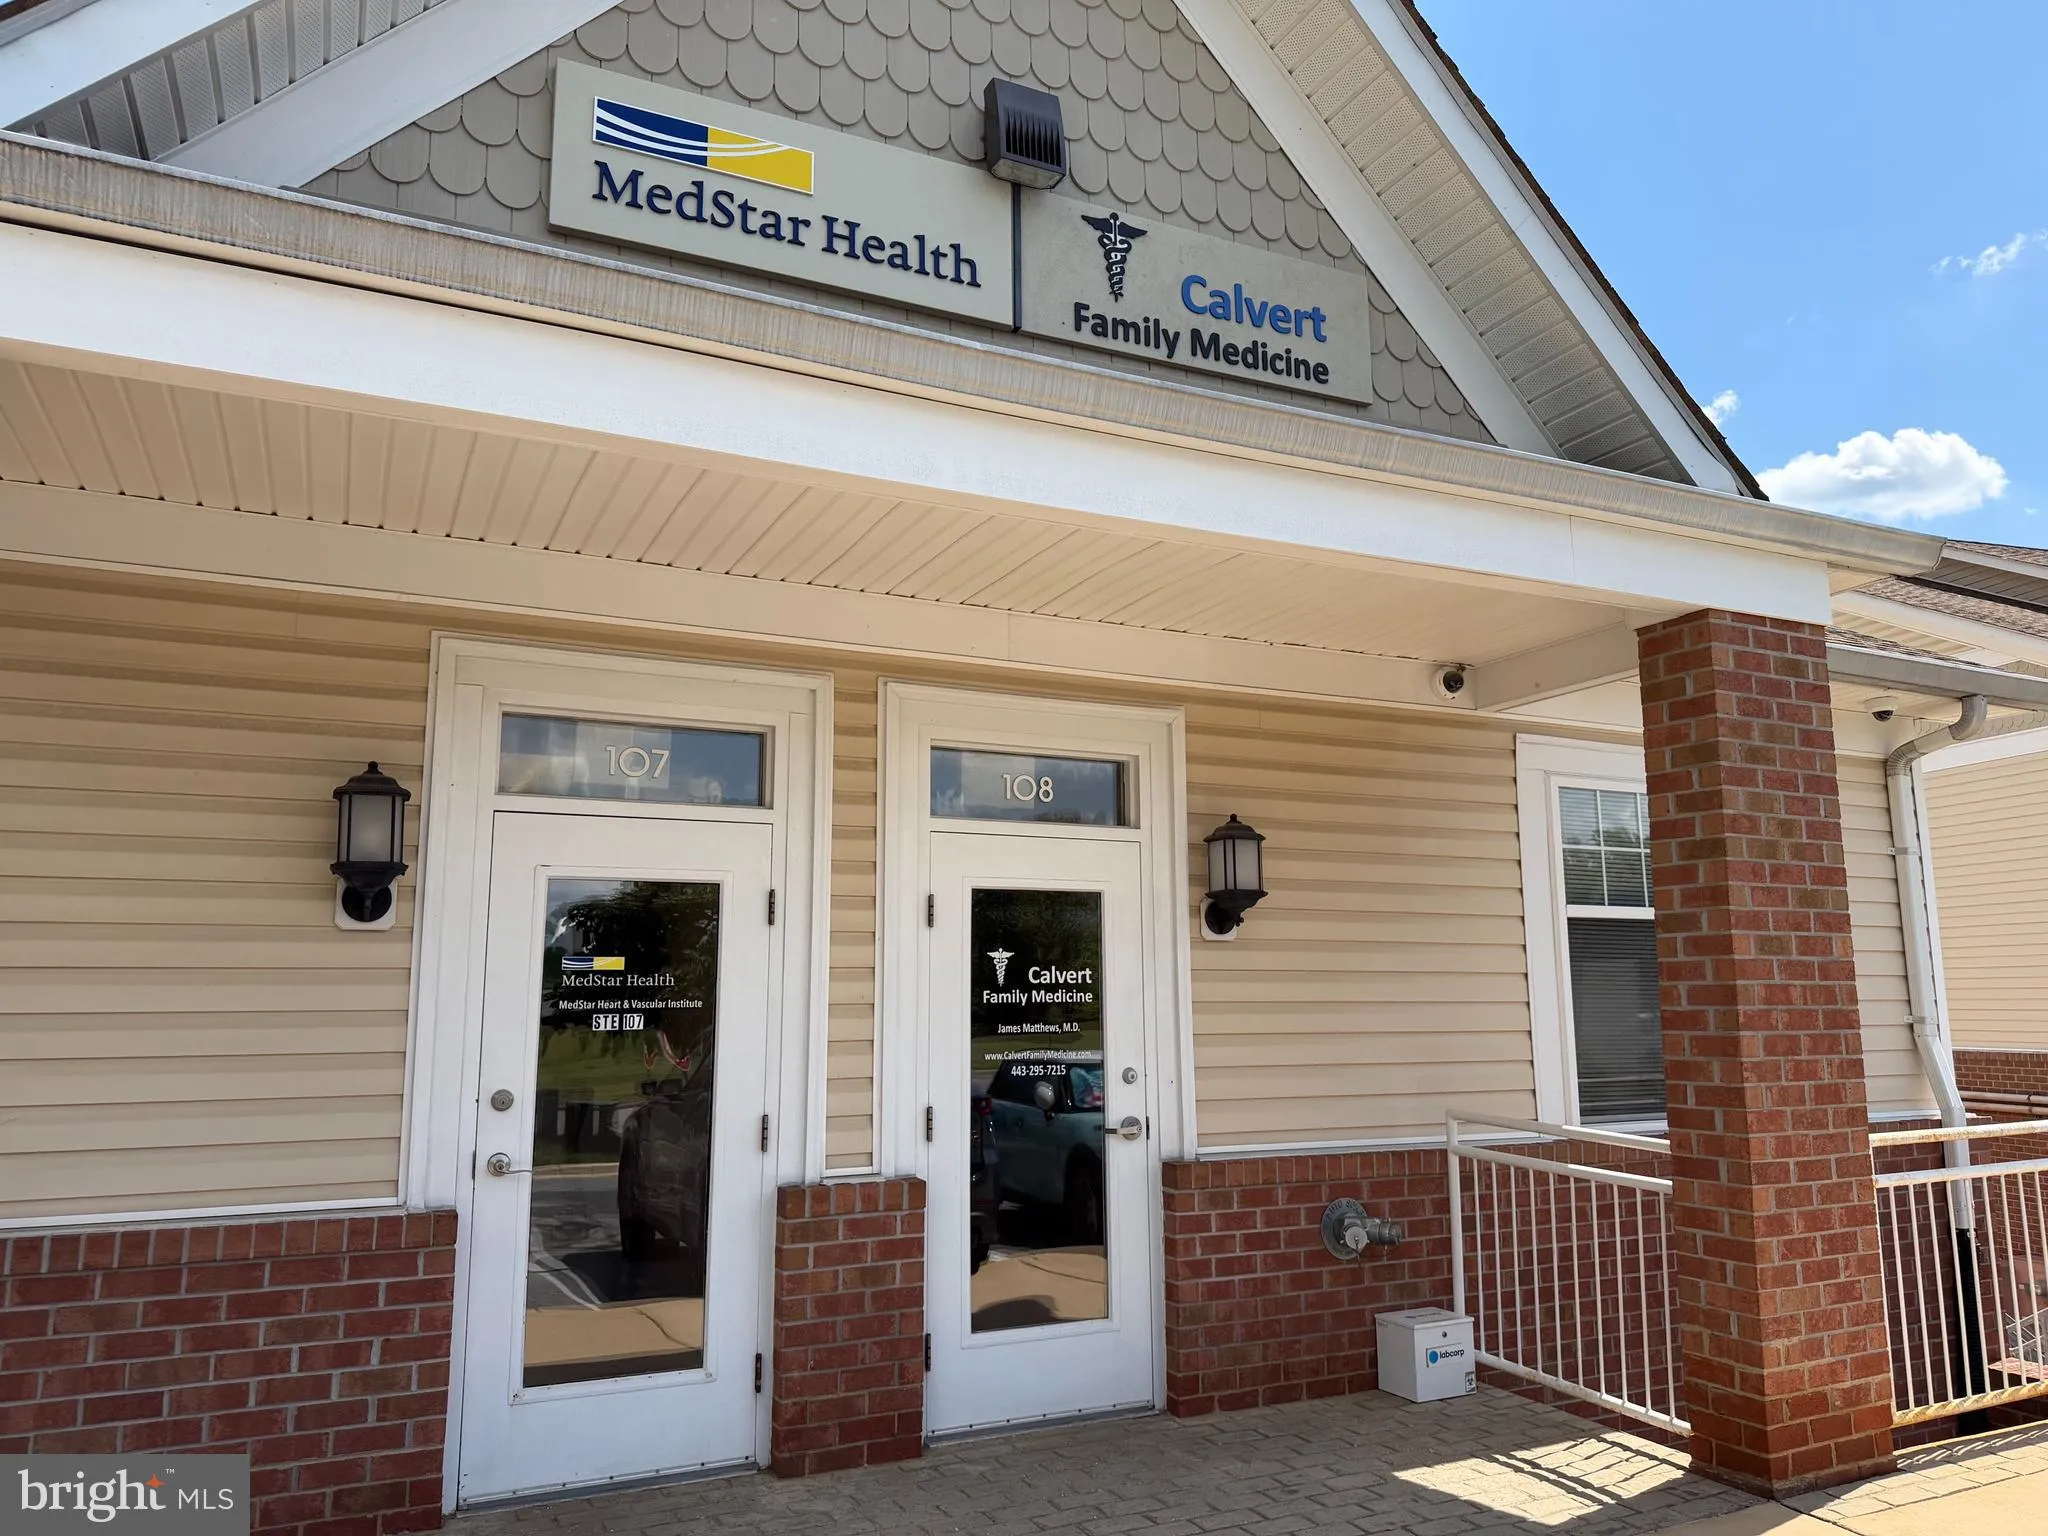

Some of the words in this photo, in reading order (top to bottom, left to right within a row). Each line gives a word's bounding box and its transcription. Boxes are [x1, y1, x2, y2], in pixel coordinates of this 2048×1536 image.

[592, 159, 811, 247] MedStar
[821, 214, 981, 288] Health
[1181, 274, 1328, 342] Calvert
[1074, 302, 1180, 359] Family
[1190, 328, 1330, 384] Medicine
[605, 744, 670, 779] 107
[1002, 773, 1054, 803] 108
[562, 974, 623, 987] MedStar
[626, 973, 675, 987] Health
[1028, 966, 1093, 984] Calvert
[559, 1000, 596, 1010] MedStar
[598, 999, 621, 1009] Heart
[623, 1000, 630, 1009] &
[631, 999, 666, 1009] Vascular
[668, 998, 703, 1008] Institute
[983, 989, 1028, 1006] Family
[1032, 989, 1093, 1003] Medicine
[593, 1014, 618, 1030] STE
[624, 1014, 643, 1029] 107
[998, 1023, 1021, 1034] James
[1022, 1023, 1061, 1034] Matthews,
[1063, 1022, 1080, 1032] M.D.
[984, 1050, 1092, 1061] www.CalvertFamilyMedicine.com
[1011, 1064, 1066, 1077] 443-295-7215
[1439, 1348, 1465, 1360] labcorp
